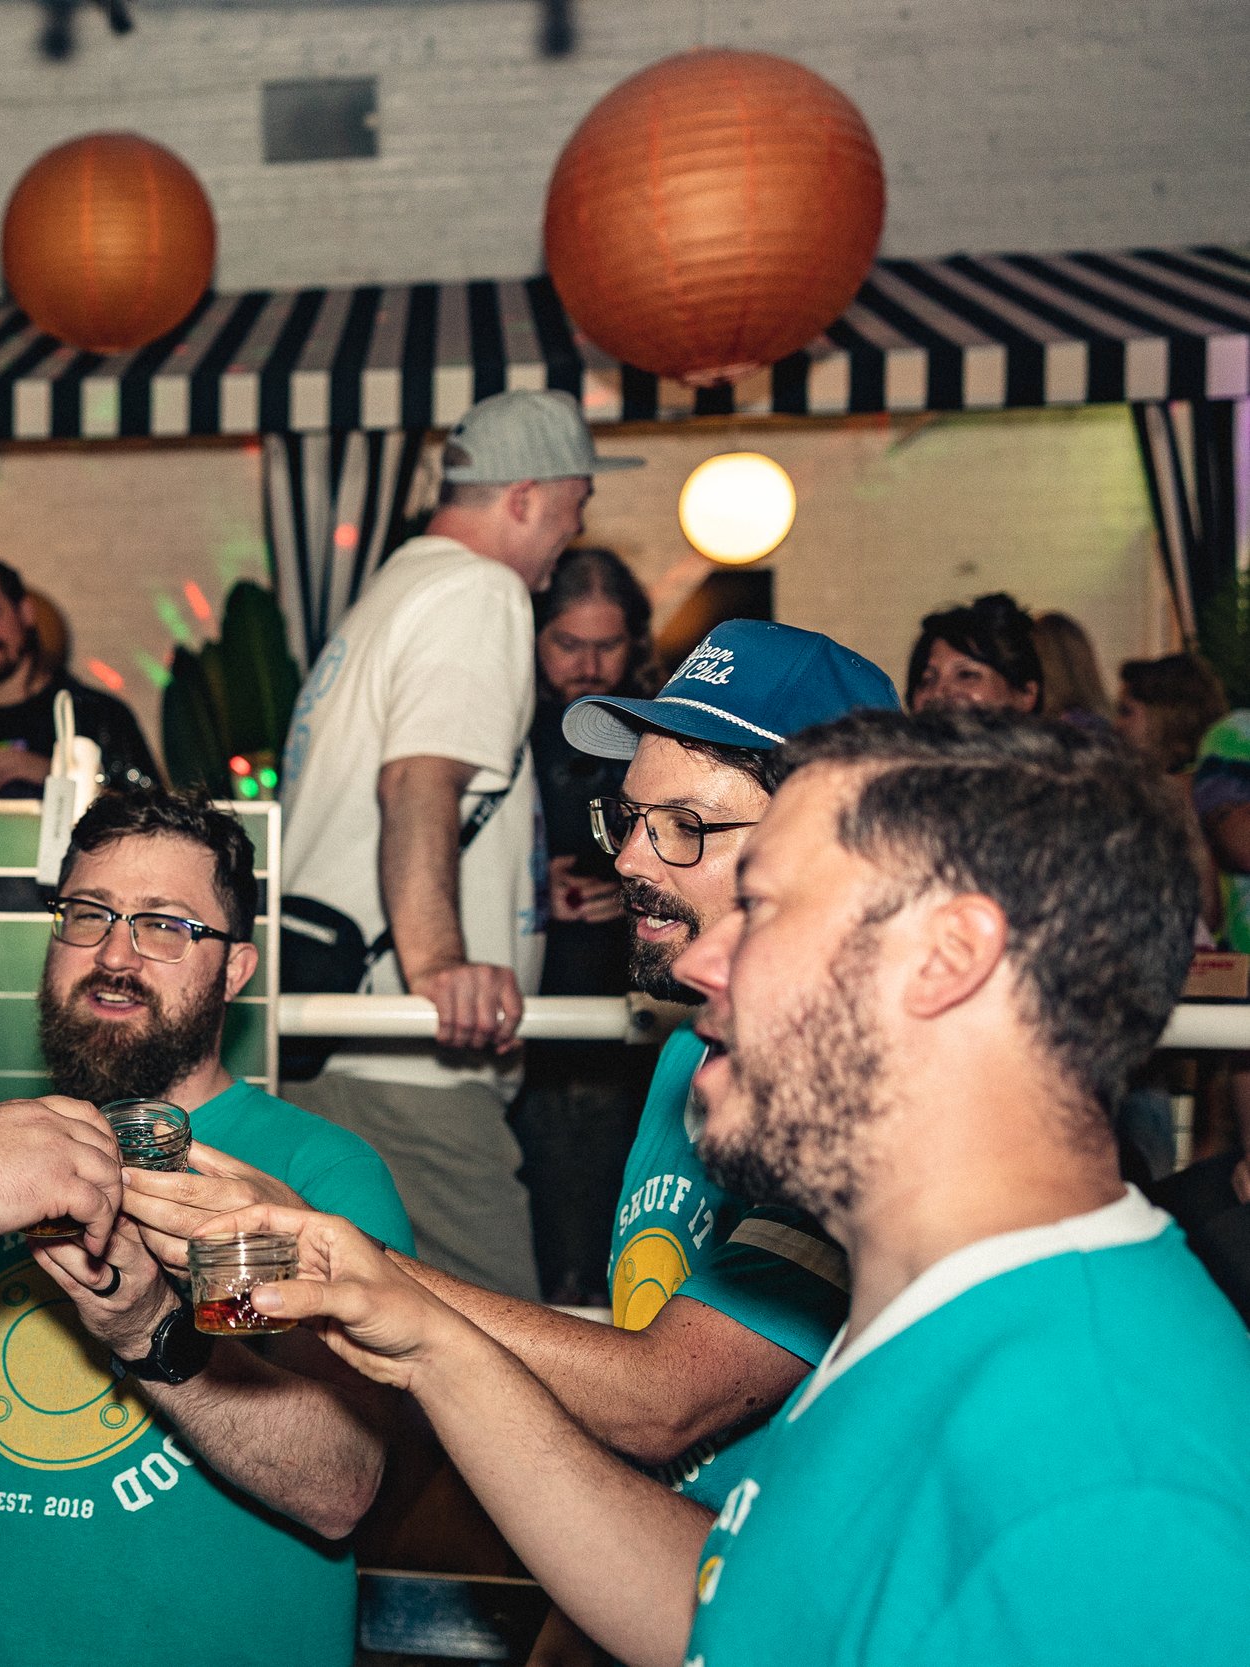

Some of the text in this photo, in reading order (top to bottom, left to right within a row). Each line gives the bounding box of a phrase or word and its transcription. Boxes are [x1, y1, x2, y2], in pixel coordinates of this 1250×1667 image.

[685, 659, 735, 685] Club
[619, 1174, 693, 1237] SHUFF
[43, 1496, 95, 1519] 2018
